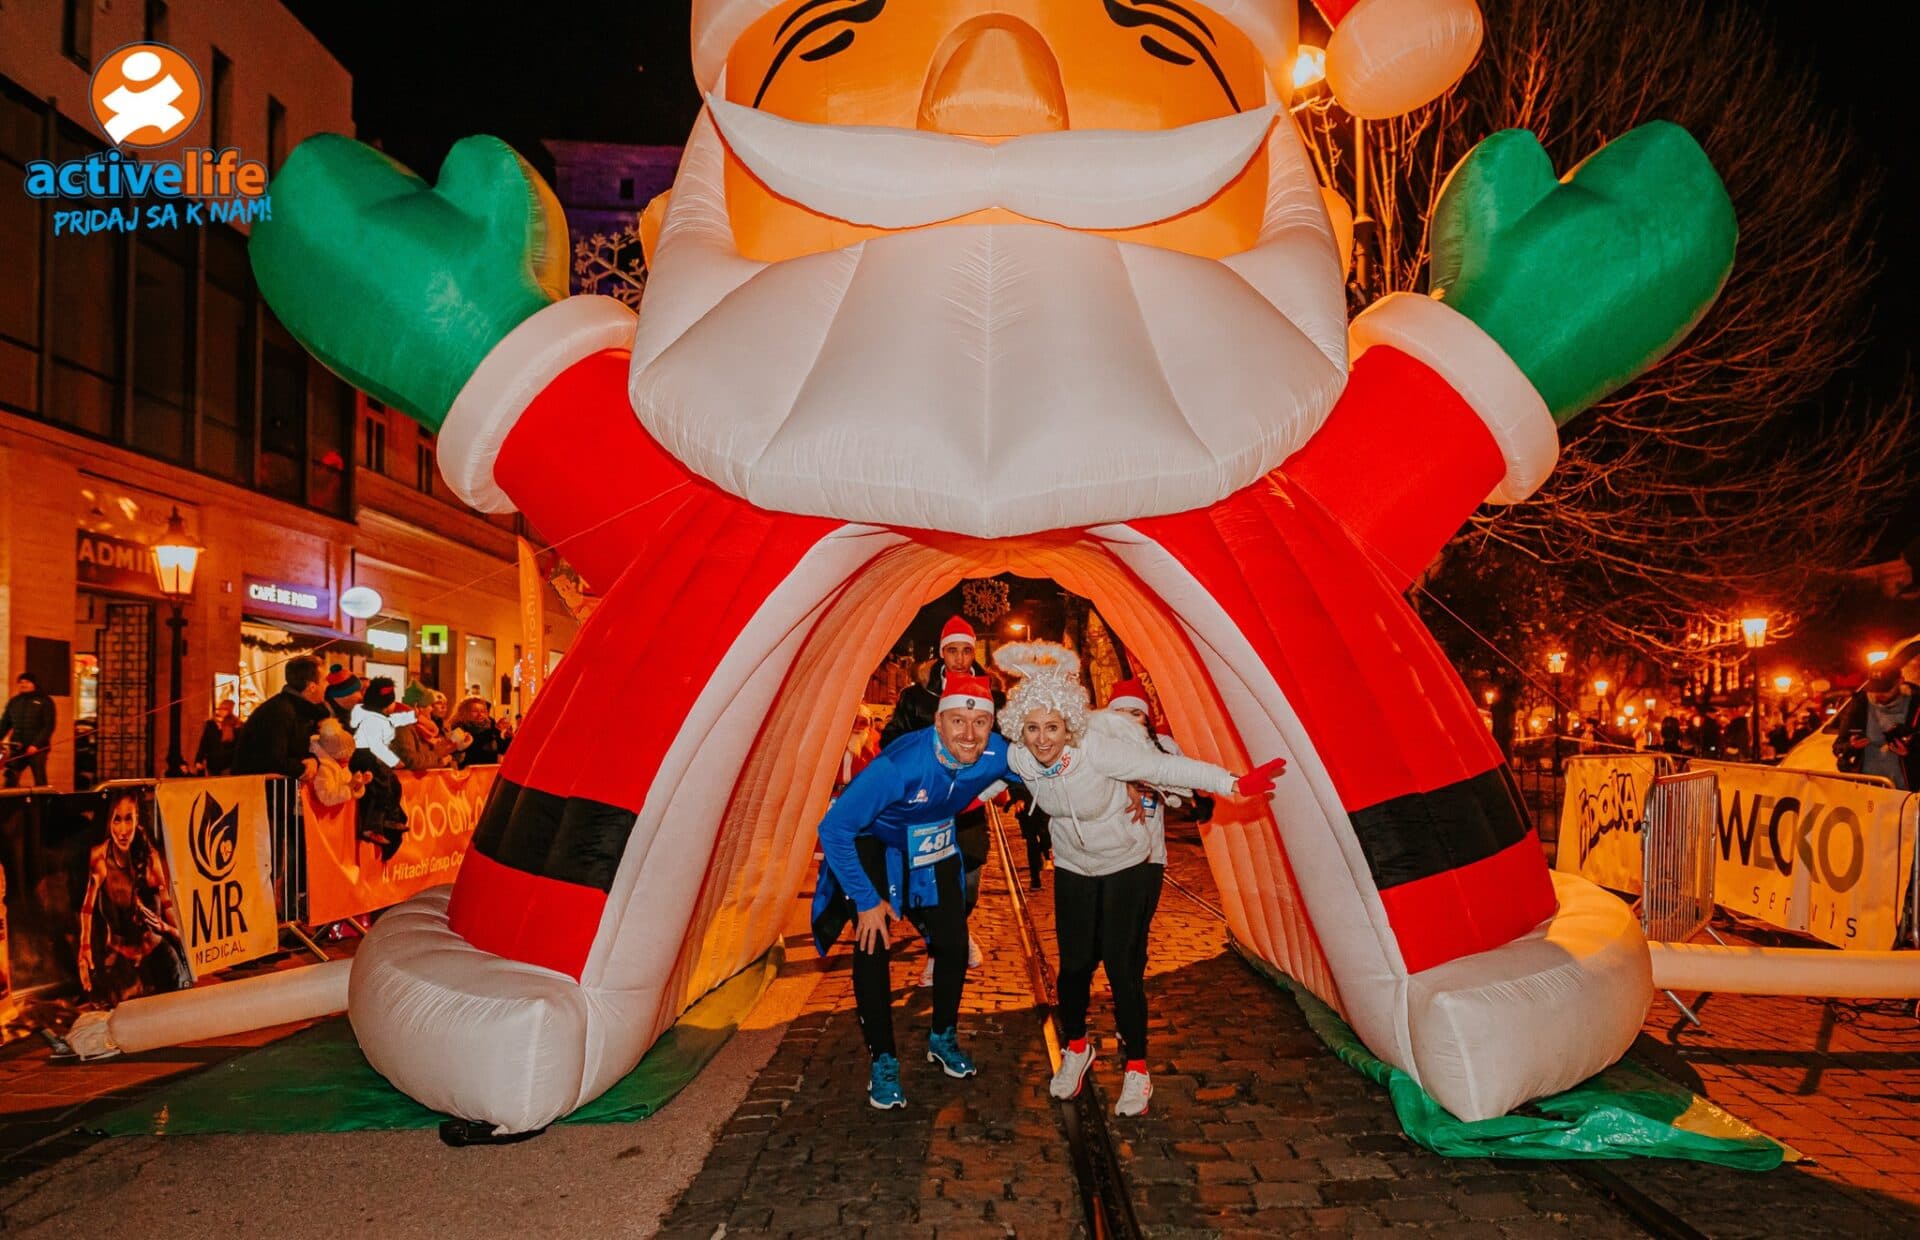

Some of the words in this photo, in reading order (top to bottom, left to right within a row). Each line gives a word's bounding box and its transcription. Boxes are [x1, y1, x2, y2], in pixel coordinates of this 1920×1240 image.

[918, 829, 952, 853] 481
[1717, 789, 1864, 894] WECKO
[392, 857, 430, 881] Hitachi
[450, 850, 464, 866] Co
[192, 880, 248, 948] MR
[195, 941, 247, 966] MEDICAL
